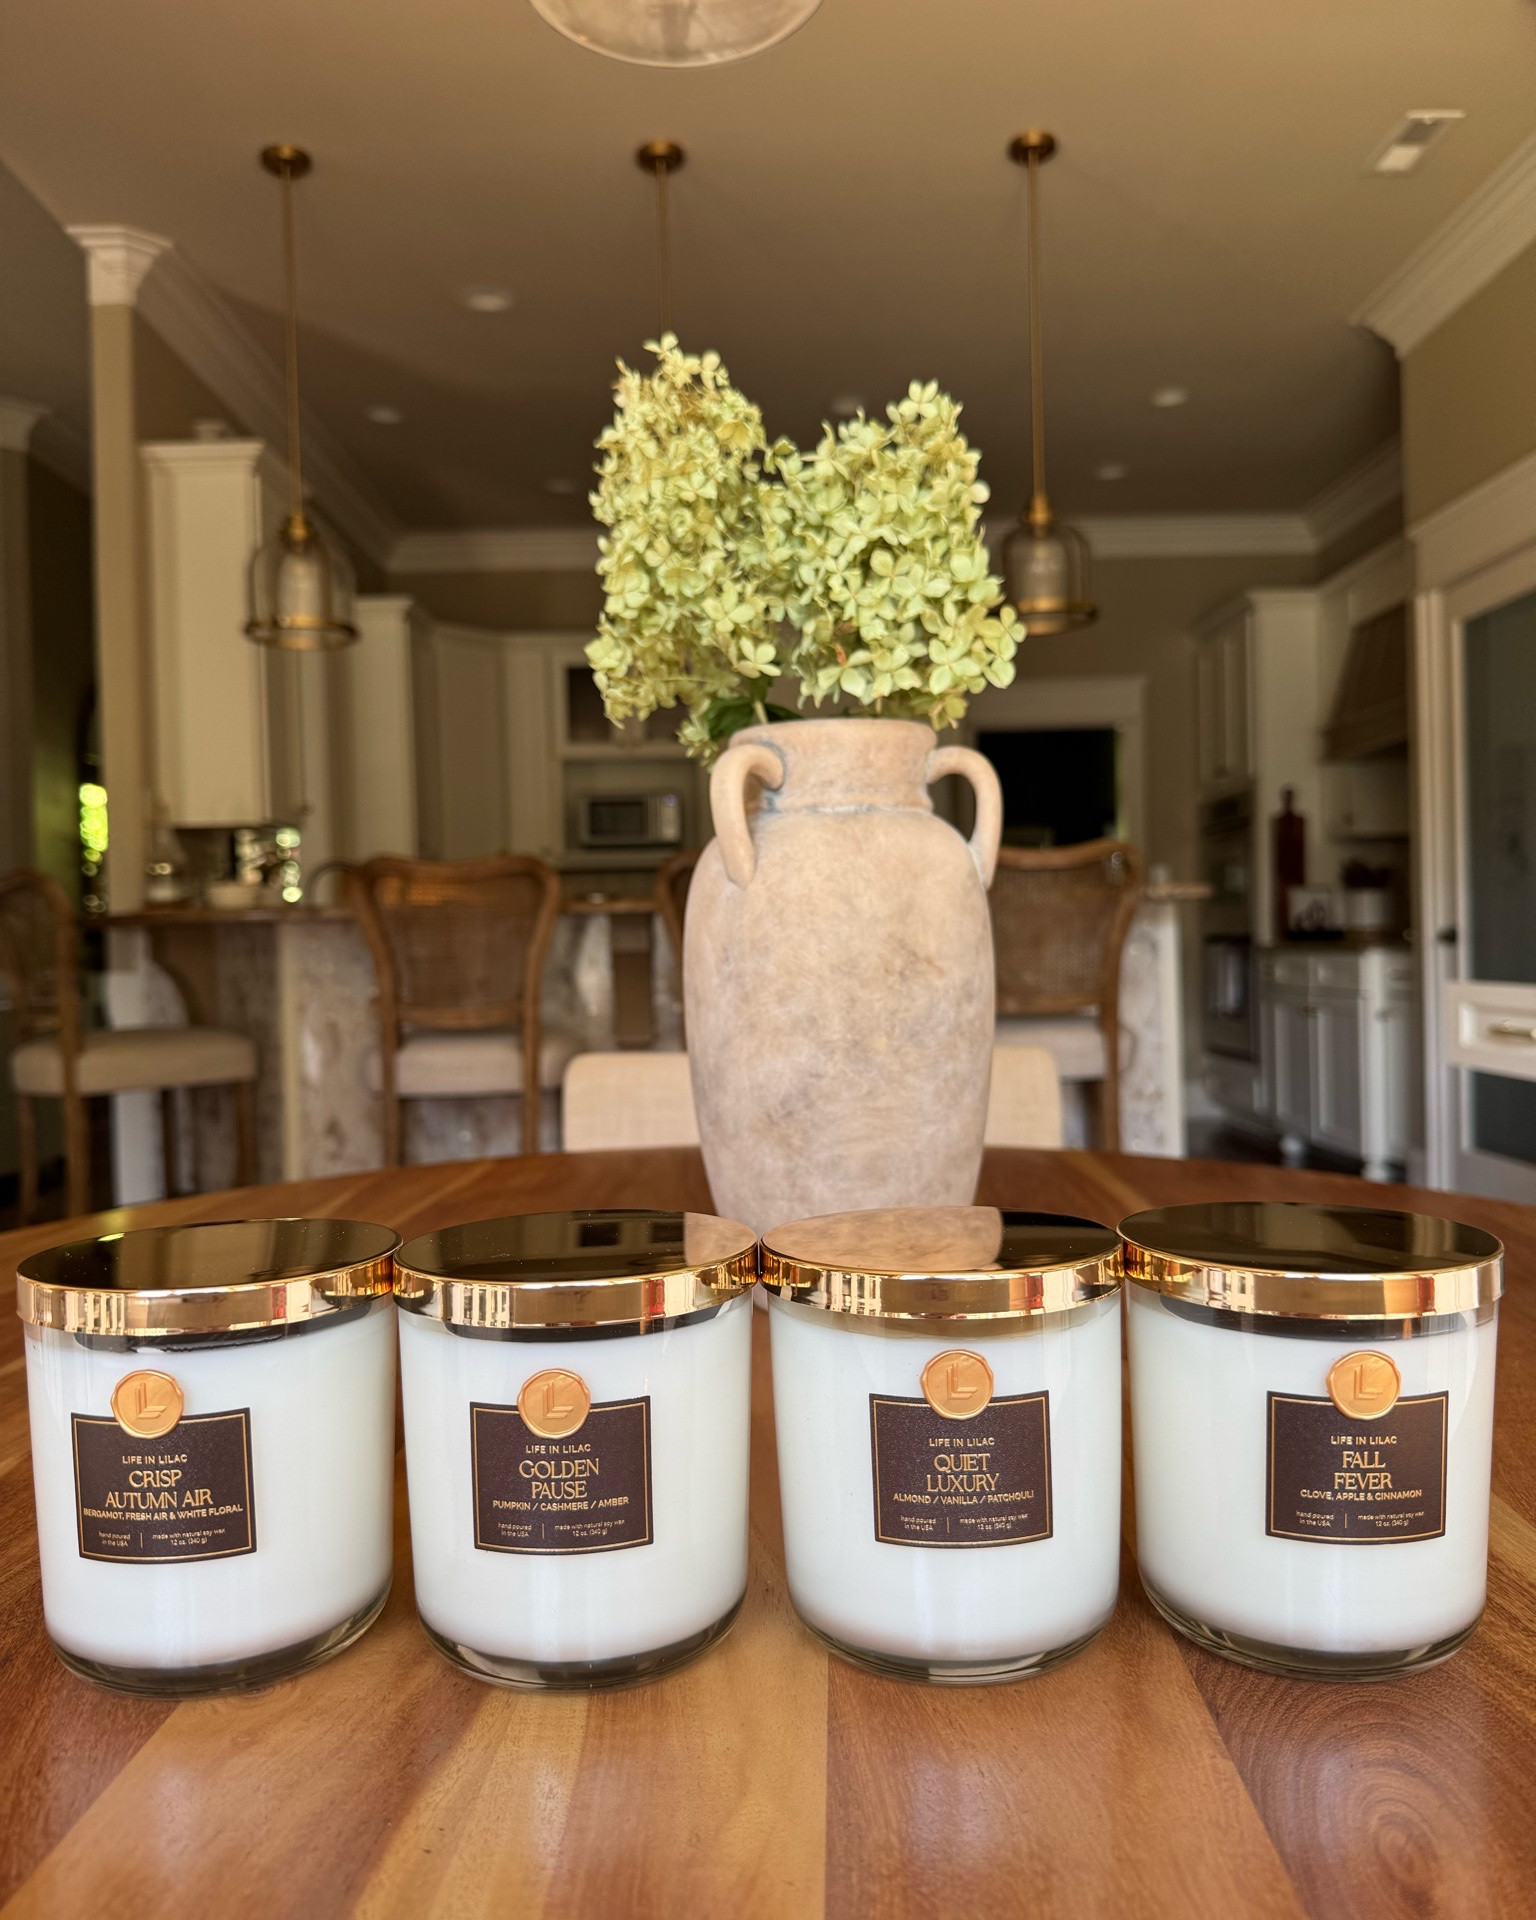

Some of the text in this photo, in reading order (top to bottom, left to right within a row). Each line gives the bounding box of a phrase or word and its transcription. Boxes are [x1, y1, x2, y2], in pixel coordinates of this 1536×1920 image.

[526, 1444, 591, 1454] LIFE IN LILAC
[929, 1437, 995, 1447] LIFE IN LILAC
[1331, 1436, 1397, 1445] LIFE IN LILAC
[122, 1454, 188, 1465] LIFE IN LILAC
[934, 1453, 991, 1474] QUIET
[1342, 1451, 1386, 1469] FALL
[518, 1458, 600, 1479] GOLDEN
[128, 1469, 183, 1488] CRISP
[926, 1472, 1000, 1493] LUXURY
[1333, 1472, 1393, 1490] FEVER
[105, 1488, 214, 1510] AUTUMN AIR
[531, 1481, 588, 1500] PAUSE
[893, 1493, 931, 1504] ALMOND
[940, 1496, 979, 1505] VANILLA
[988, 1490, 1034, 1504] PATCHOULI
[1300, 1489, 1422, 1500] CLOVE, APPLE & CINNAMON
[83, 1504, 243, 1520] BERGAMOT, FRESH AIR & WHITE FLORAL
[492, 1500, 530, 1510] PUMPKIN
[541, 1501, 588, 1511] CASHMERE
[598, 1496, 629, 1508] AMBER
